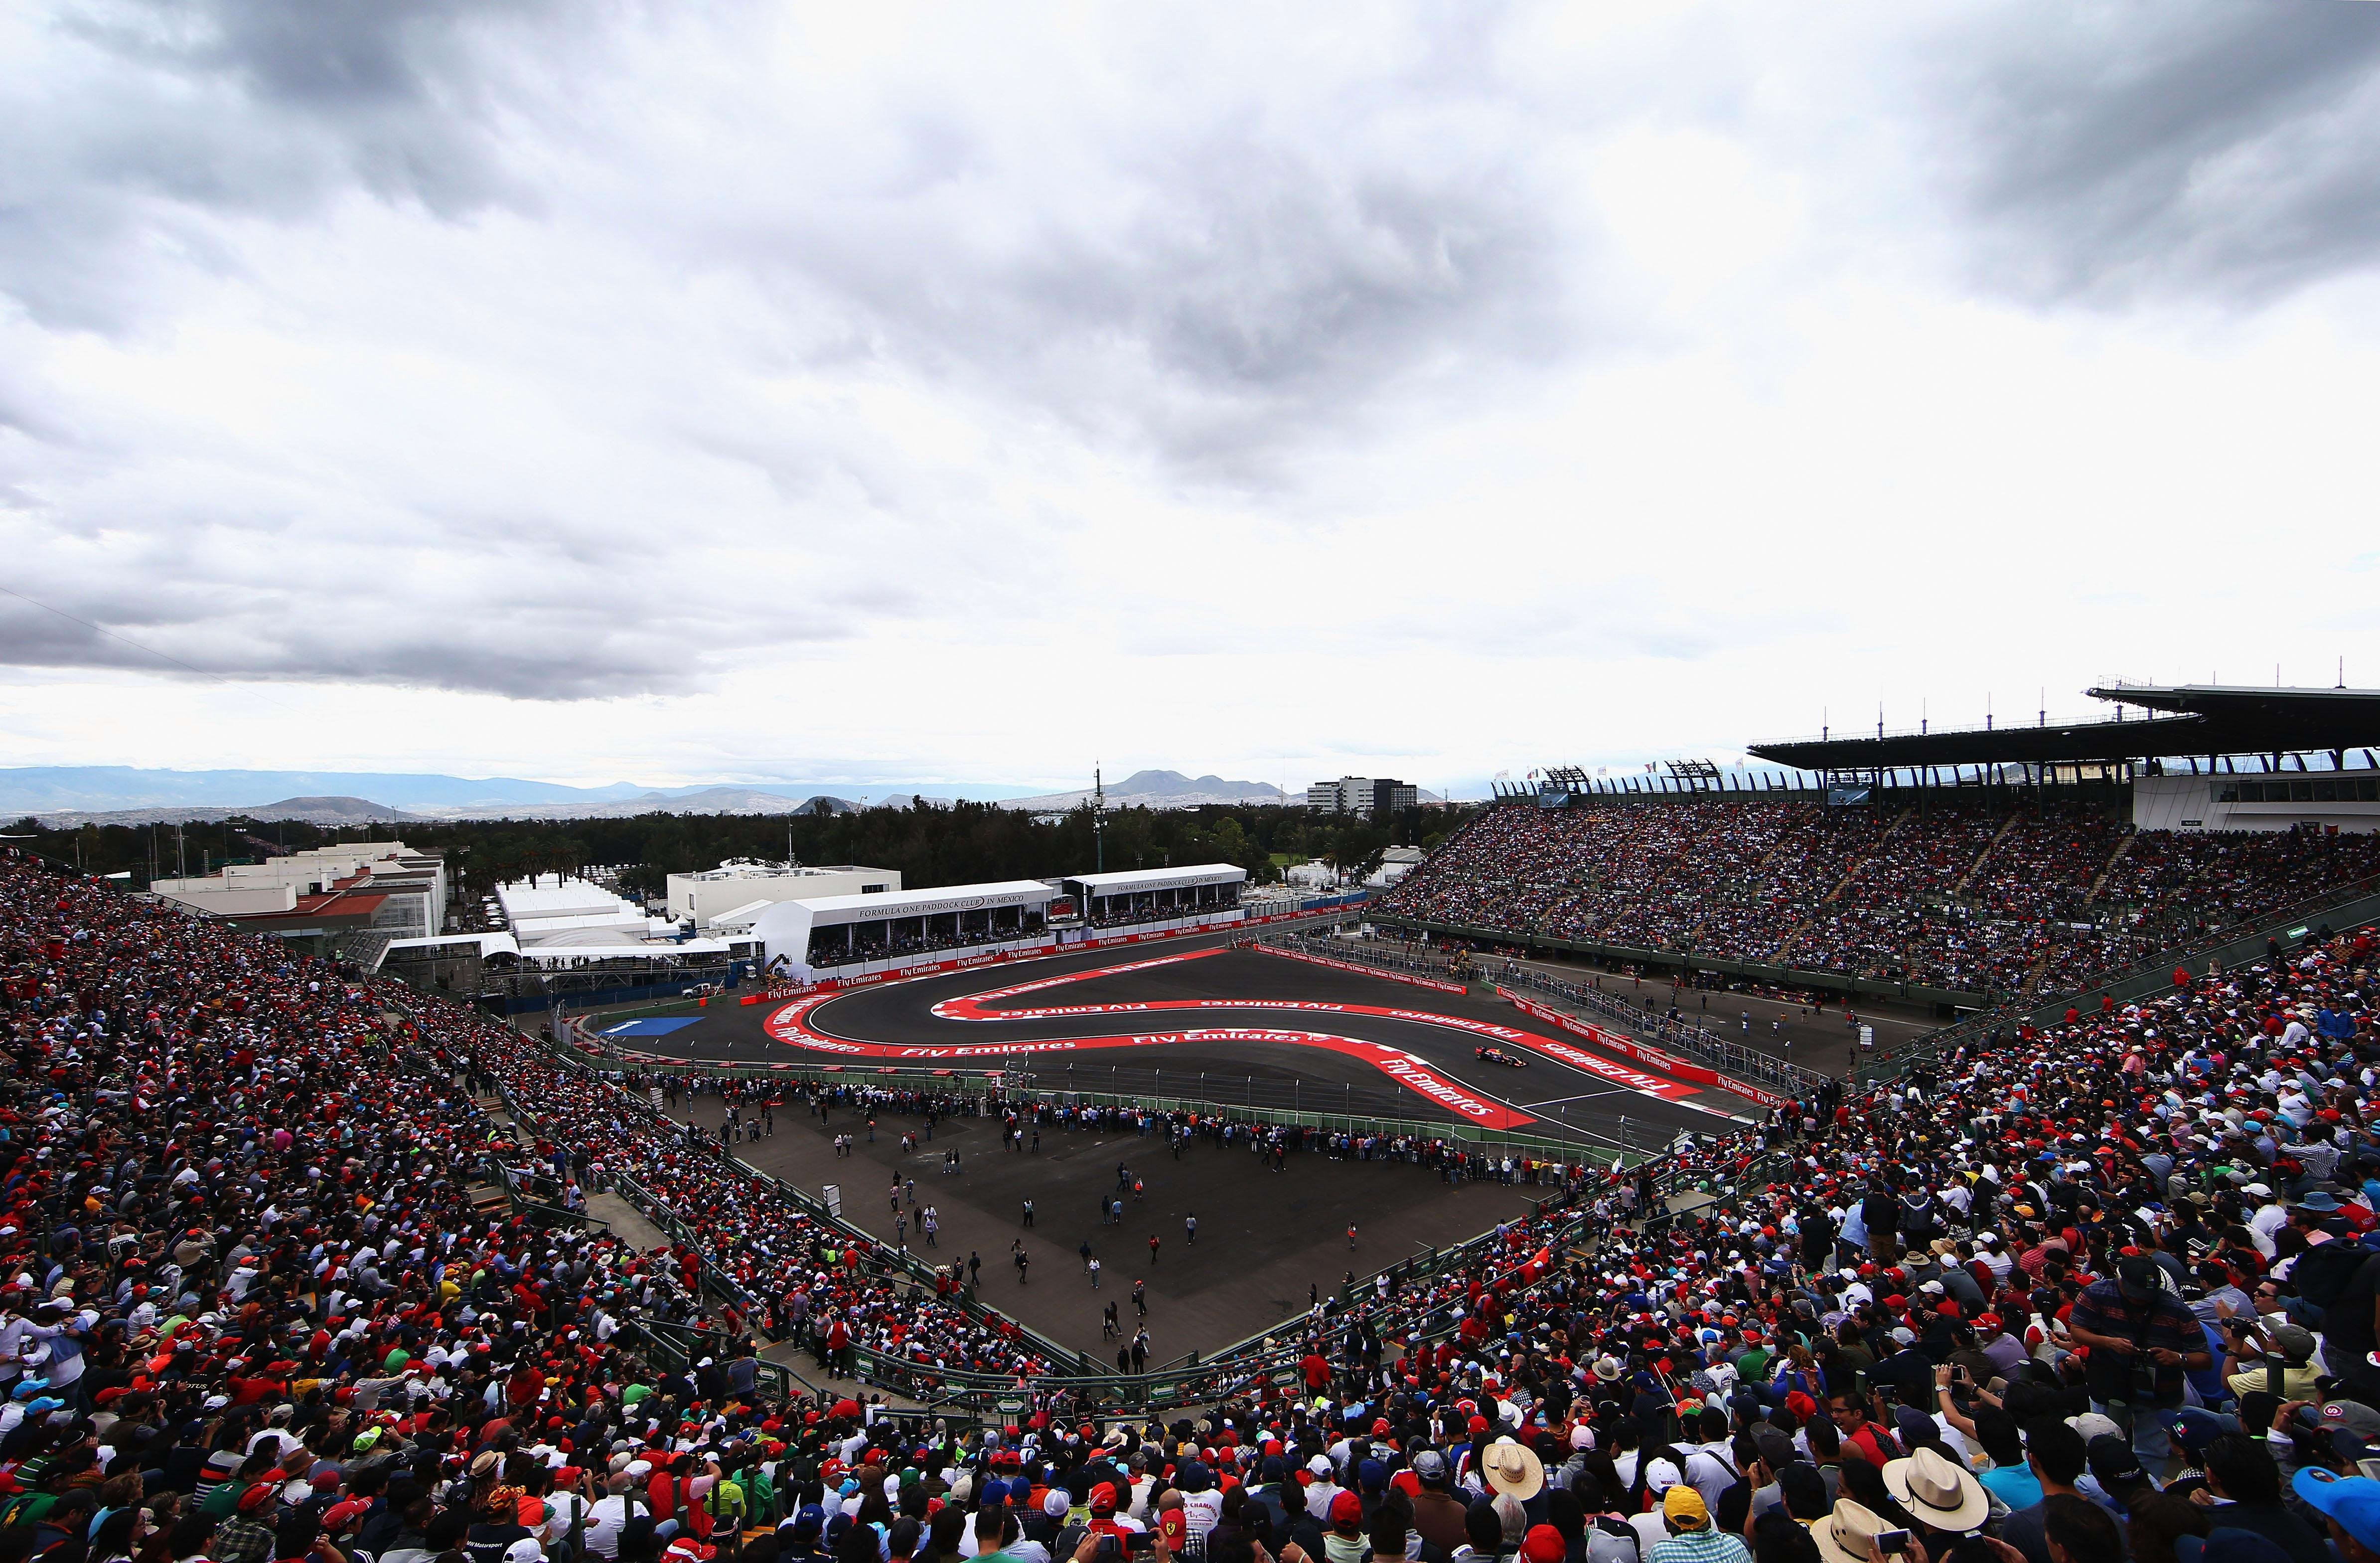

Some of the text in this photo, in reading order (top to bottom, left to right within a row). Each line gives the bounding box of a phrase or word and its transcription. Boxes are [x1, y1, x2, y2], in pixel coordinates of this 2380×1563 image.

[860, 907, 900, 918] FORMULA
[902, 905, 920, 913] ONE
[922, 901, 959, 911] PADDOCK
[961, 898, 980, 907] CLUB
[968, 954, 994, 964] Emirates
[1019, 948, 1041, 957] Emirates
[913, 964, 940, 974] Emirates
[838, 974, 882, 987] Fly Emirates
[768, 985, 817, 999] Fly Emirates
[971, 977, 1076, 1002] Fly Emirates
[1000, 1006, 1104, 1017] Emirates
[1539, 1009, 1555, 1022] Emirates
[1388, 1010, 1524, 1039] Fly Emirates
[1571, 1022, 1589, 1036] Emirates
[775, 1026, 865, 1052] Fly Emirates
[1131, 1032, 1302, 1044] Fly Emirates
[1597, 1033, 1627, 1052] Fly Emirates
[900, 1041, 1076, 1057] Fly Emirates
[1540, 1043, 1671, 1091] Fly Emirates
[1637, 1050, 1671, 1071] Fly Emirates
[1380, 1059, 1494, 1115] Fly Emirates
[1718, 1076, 1754, 1096] Fly Emirates
[1190, 1502, 1218, 1518] CHAMPION
